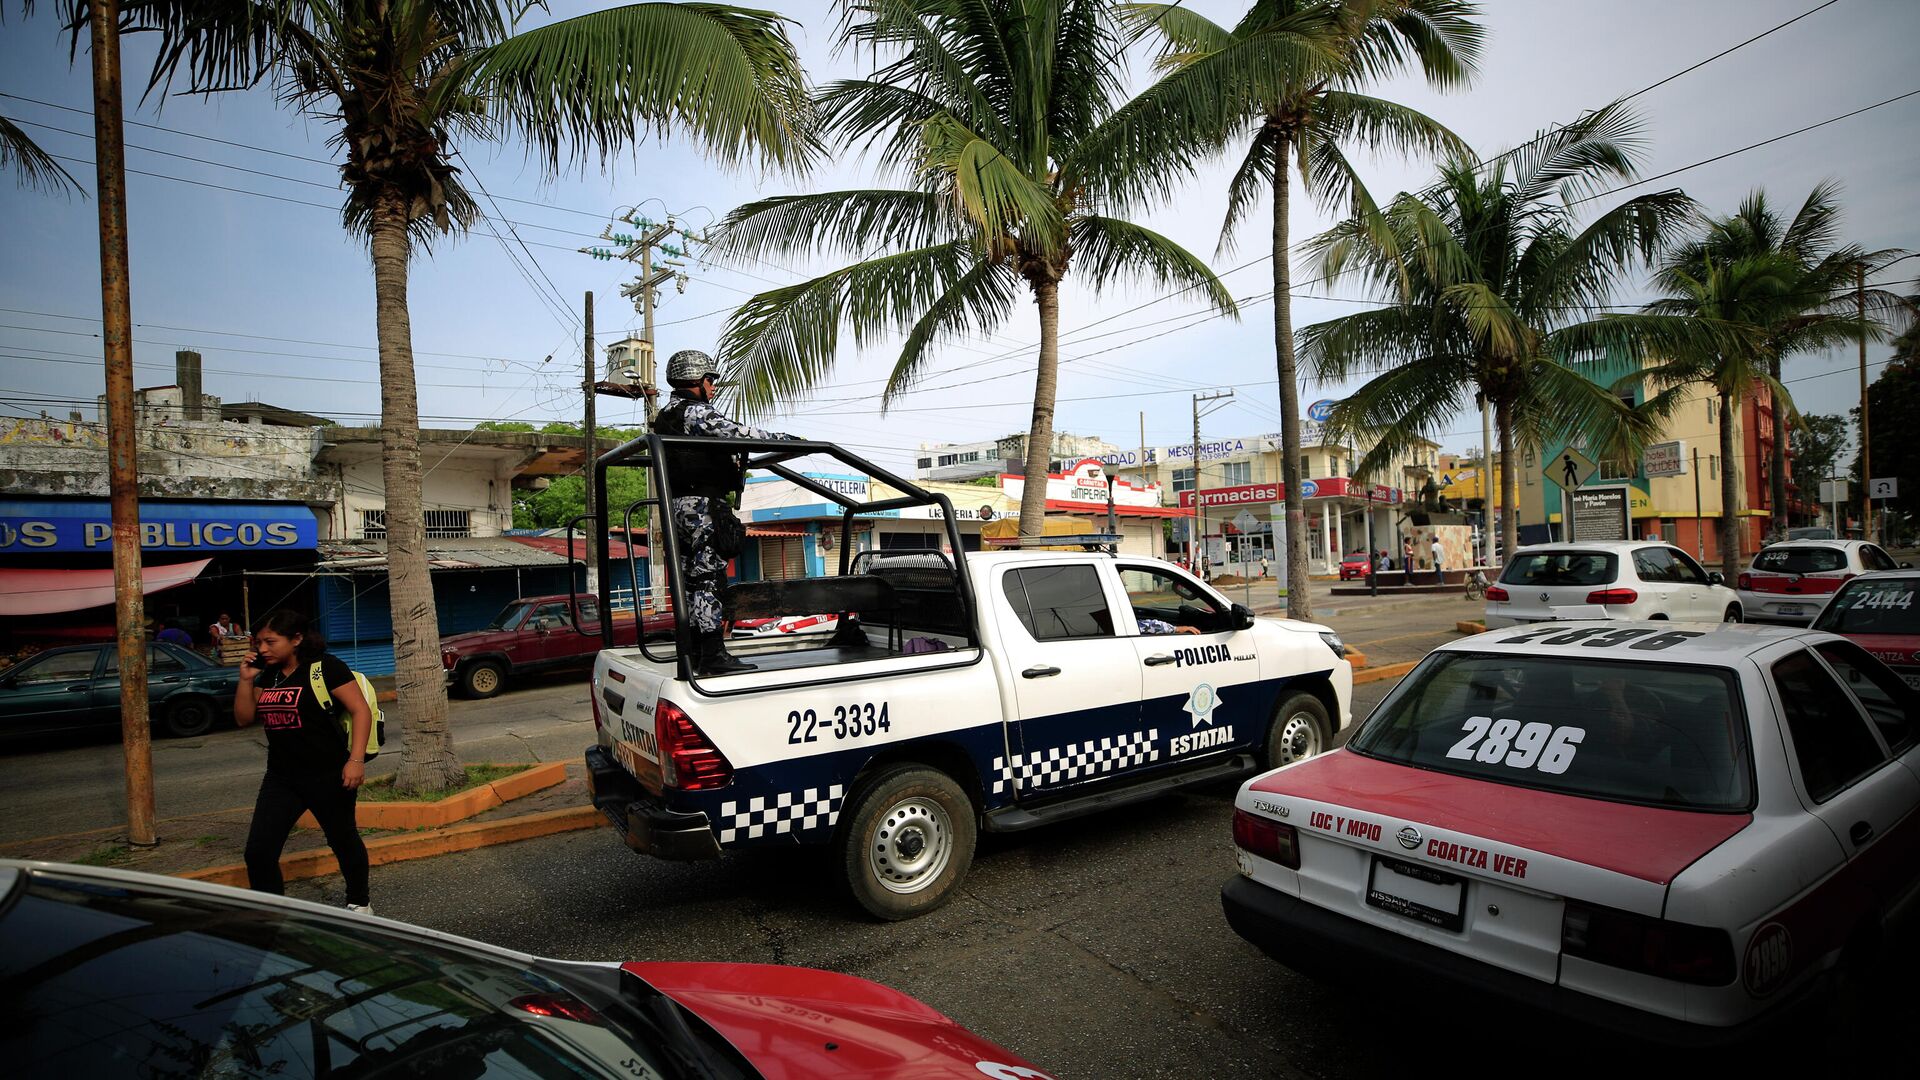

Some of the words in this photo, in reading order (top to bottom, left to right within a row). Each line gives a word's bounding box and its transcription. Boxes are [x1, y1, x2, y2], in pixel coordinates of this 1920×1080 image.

[1168, 440, 1243, 458] MESOMERICA
[1583, 494, 1598, 502] María
[1599, 493, 1621, 501] Morelos
[84, 521, 299, 547] PBLICOS
[1764, 552, 1789, 561] 3326
[1850, 590, 1915, 610] 2444
[1496, 627, 1706, 651] 2896
[1174, 644, 1231, 668] POLICIA
[259, 690, 295, 704] WHAT'S
[787, 701, 891, 745] 22-3334
[1170, 725, 1235, 757] ESTATAL
[1446, 716, 1586, 775] 2896
[1253, 800, 1291, 818] TSURU
[1309, 811, 1333, 830] LOC
[1336, 816, 1346, 833] Y
[1346, 819, 1382, 842] MPIO
[1427, 838, 1488, 870] COATZA
[1493, 853, 1528, 879] VER
